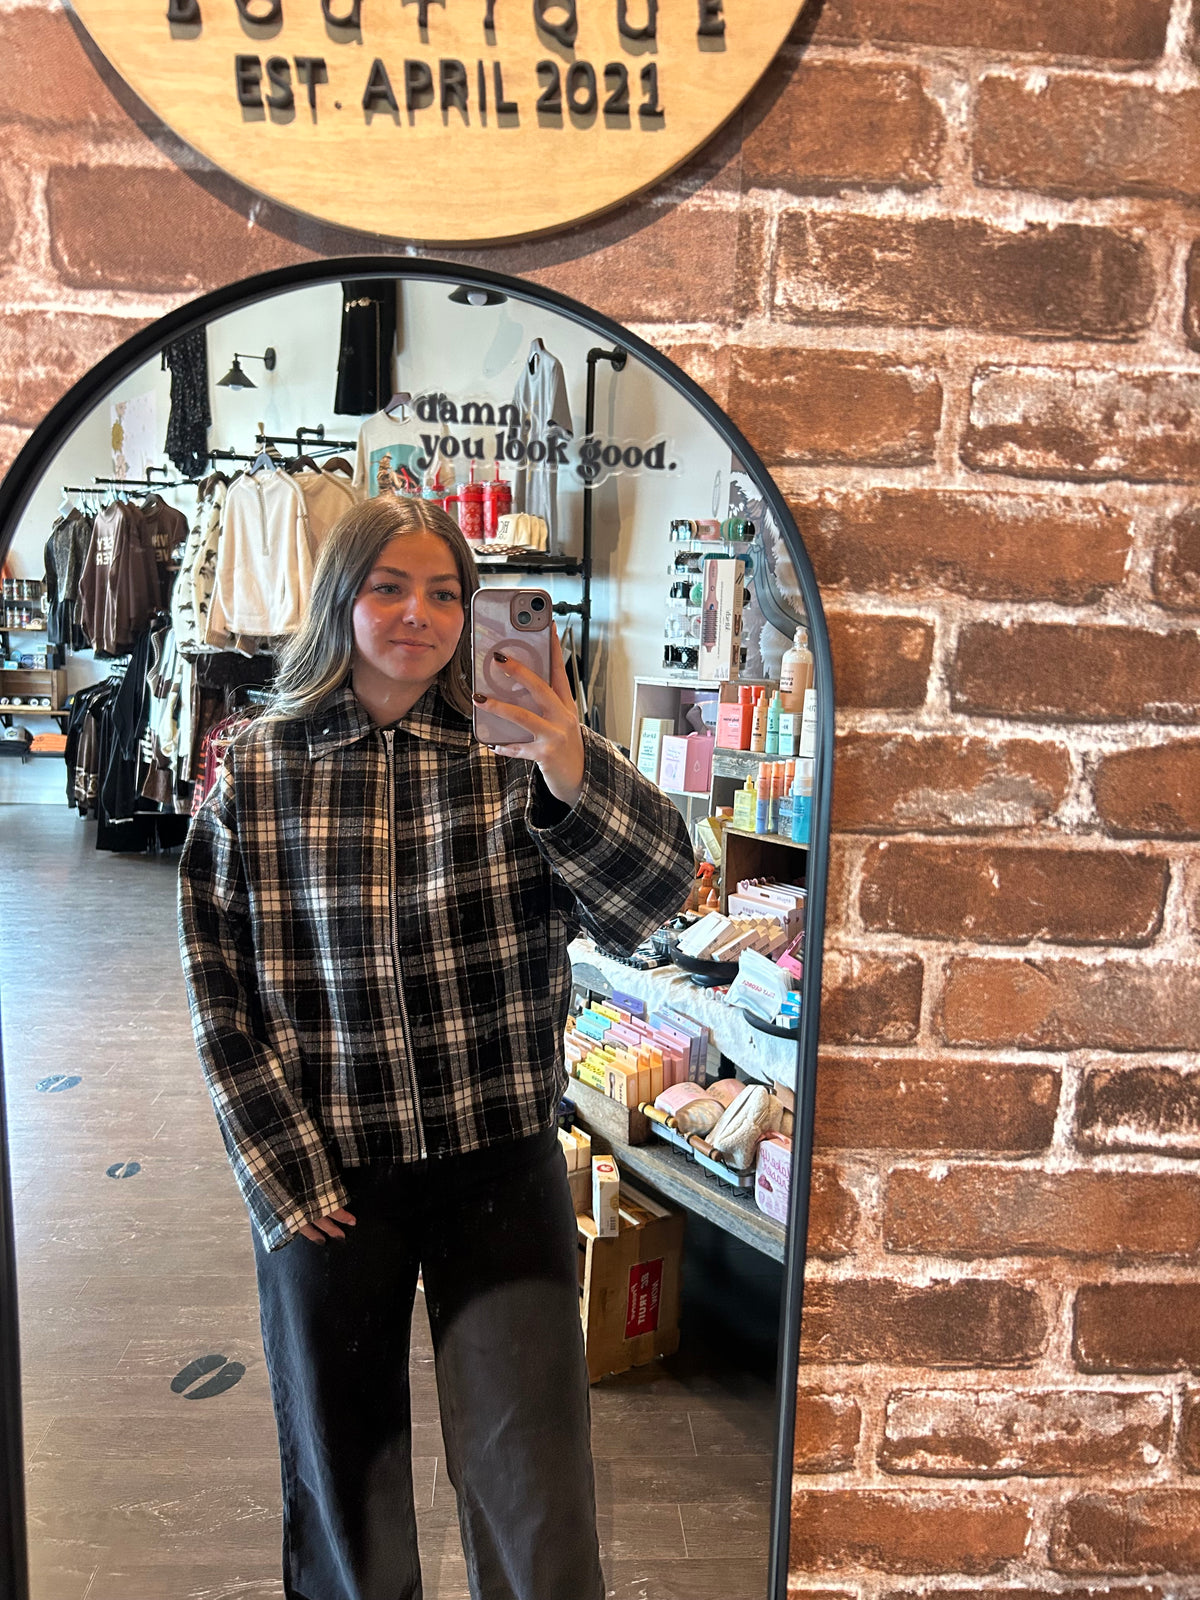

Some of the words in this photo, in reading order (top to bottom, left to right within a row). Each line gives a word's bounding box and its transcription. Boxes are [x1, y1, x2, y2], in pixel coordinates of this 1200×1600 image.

[235, 54, 342, 110] EST.
[362, 57, 518, 114] APRIL
[535, 60, 665, 118] 2021
[417, 434, 485, 470] you
[495, 431, 569, 465] look
[576, 440, 677, 479] good.
